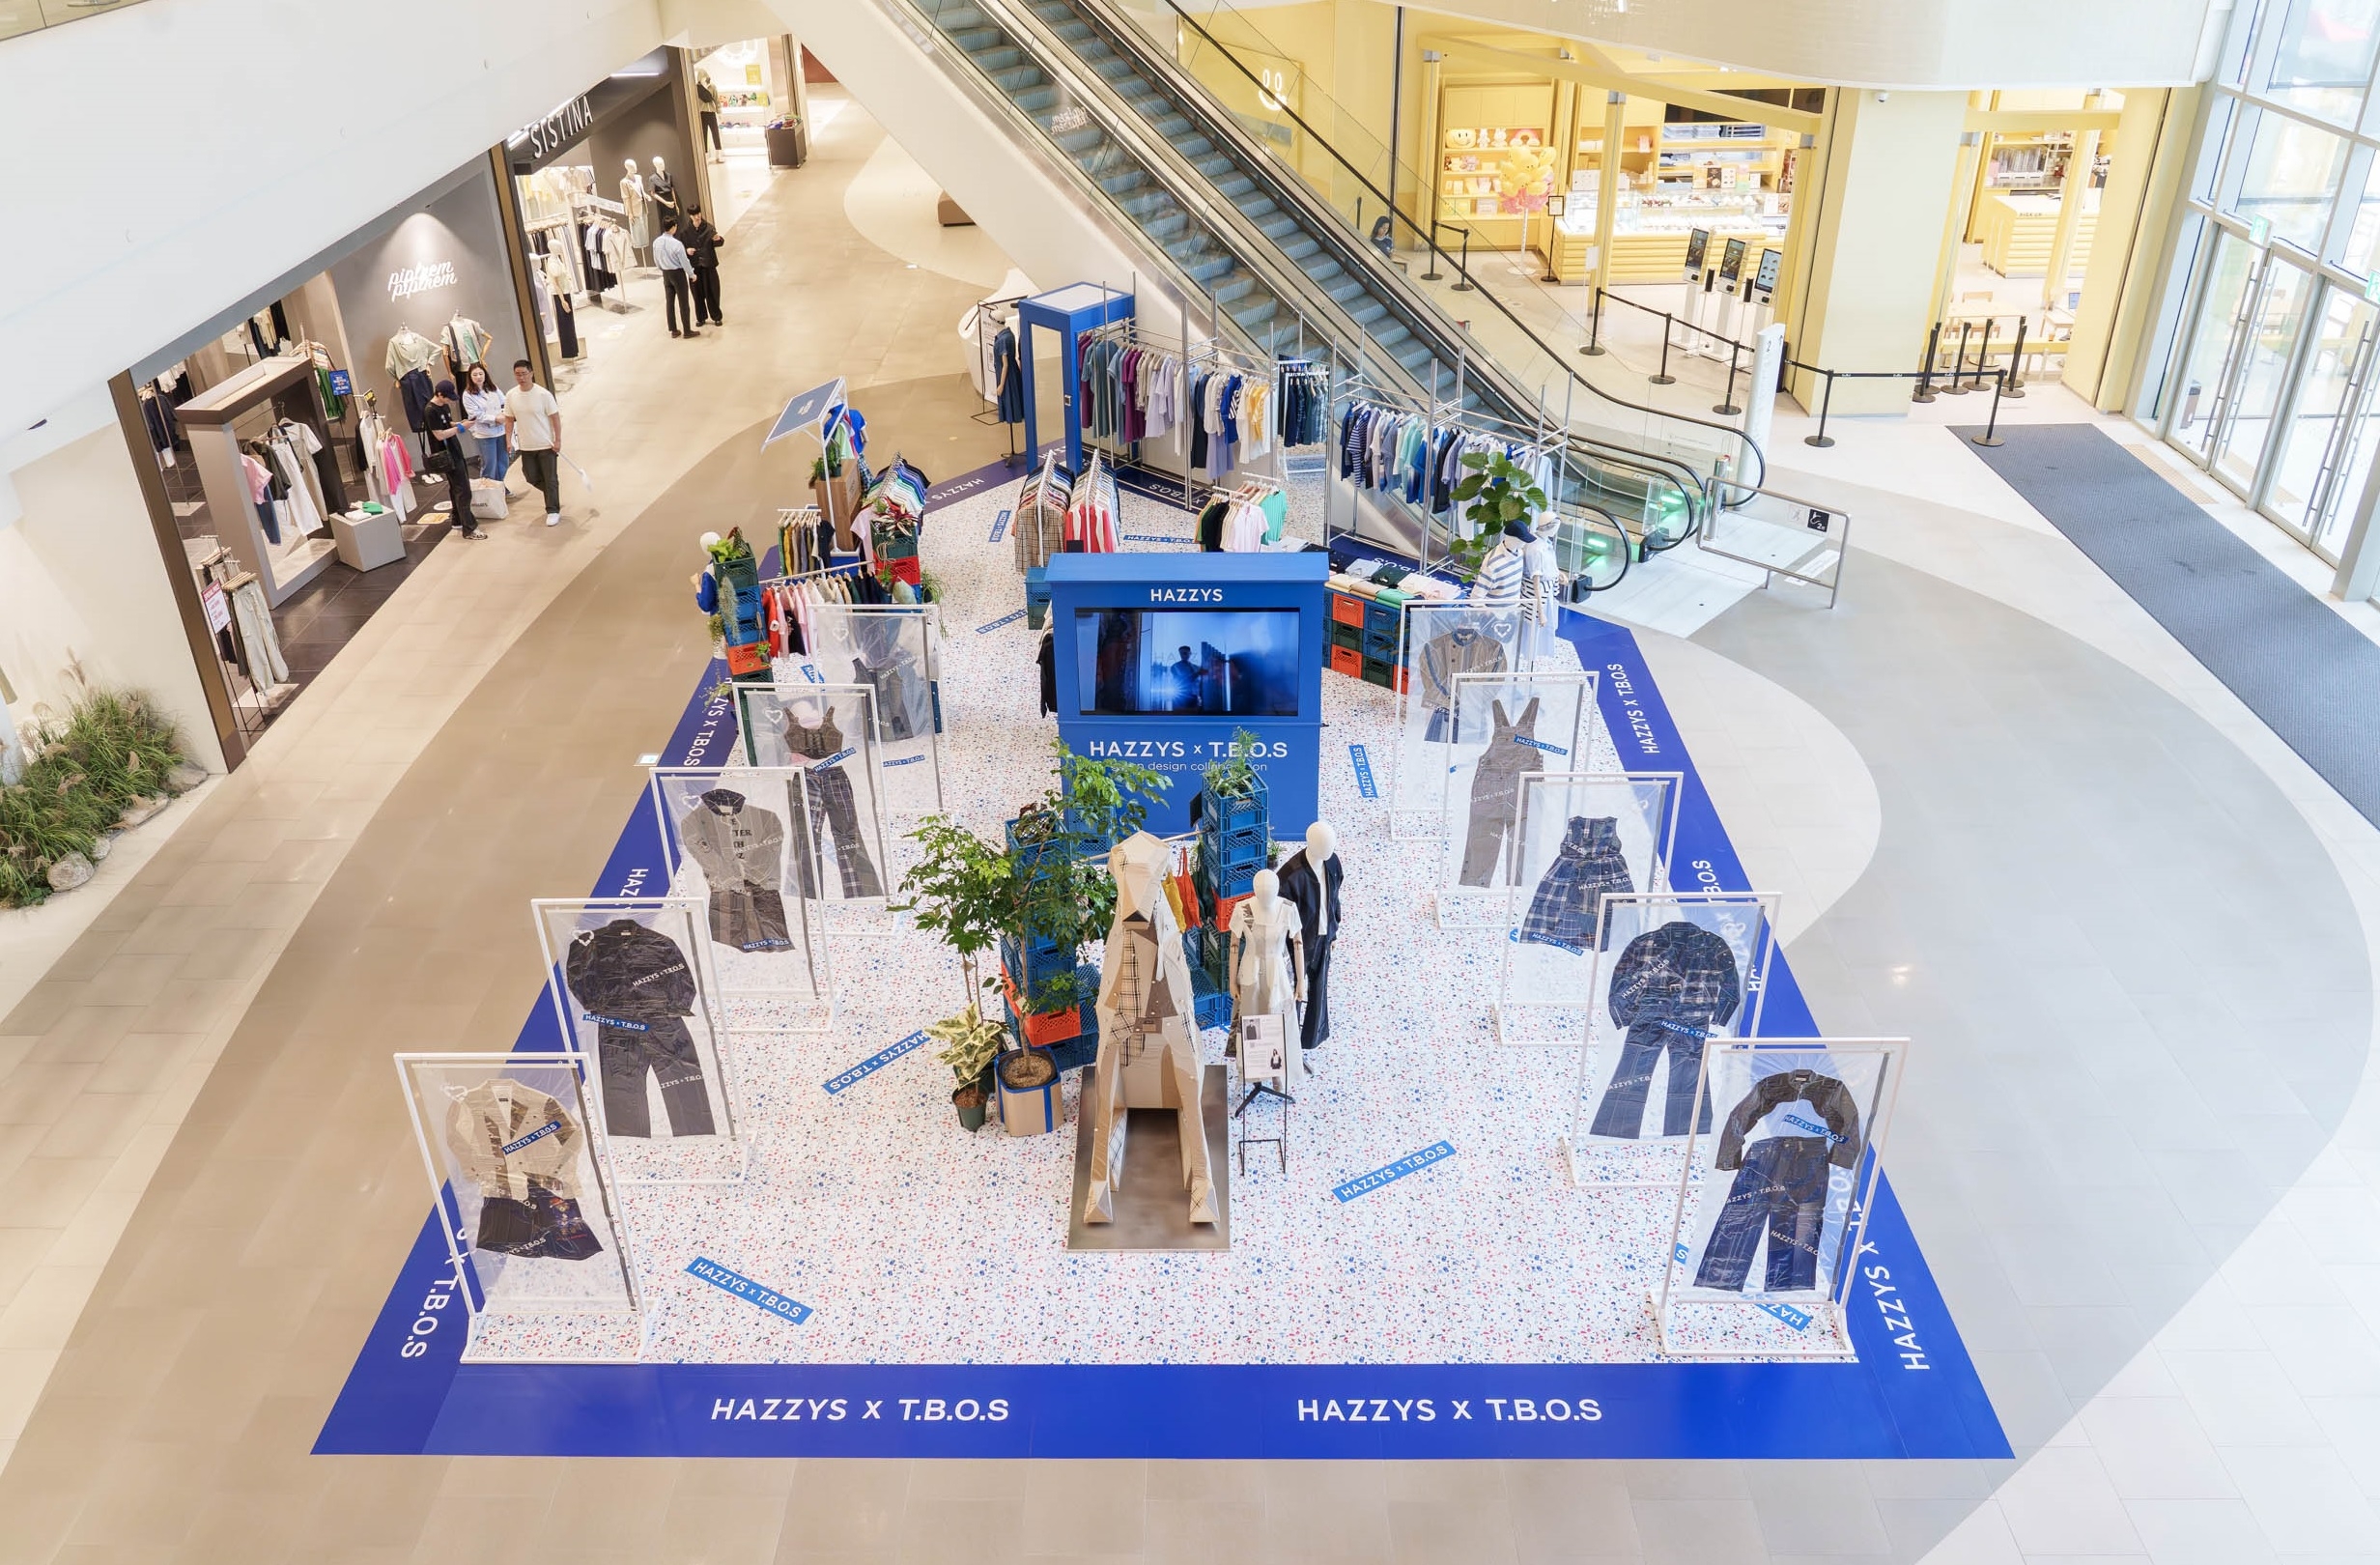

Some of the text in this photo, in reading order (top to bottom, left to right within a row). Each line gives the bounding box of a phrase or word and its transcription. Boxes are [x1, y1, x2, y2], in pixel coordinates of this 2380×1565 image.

[531, 96, 593, 158] SISTINA
[931, 478, 984, 500] HAZZYS
[1150, 588, 1224, 602] HAZZYS
[1606, 664, 1634, 697] T.B.O.S
[1516, 737, 1540, 748] HAZZYS
[1627, 710, 1660, 754] HAZZYS
[683, 729, 715, 767] T.B.O.S
[1090, 741, 1185, 757] HAZZYS
[1208, 741, 1288, 758] T.B.O.S
[1148, 762, 1187, 772] design
[1359, 771, 1375, 797] HAZZYS
[619, 868, 649, 896] HAZ
[743, 940, 768, 950] HAZZYS
[1532, 932, 1555, 945] HAZZYS
[632, 974, 660, 986] HAZZYS
[663, 963, 686, 975] T.B.O.S
[1621, 978, 1646, 999] HAZZYS
[585, 1014, 614, 1025] HAZZYS
[621, 1021, 645, 1031] T.B.O.S
[1661, 1020, 1688, 1033] HAZZYS
[879, 1032, 928, 1063] HAZZYS
[829, 1065, 873, 1090] T.B.O.S
[1785, 1115, 1814, 1130] HAZZYS
[503, 1137, 531, 1153] HAZZYS
[534, 1124, 557, 1137] T.B.O.S
[1341, 1168, 1396, 1198] HAZZYS
[1403, 1145, 1448, 1169] T.B.O.S
[1727, 1192, 1752, 1204] AZZYS
[1771, 1230, 1799, 1246] HAZZYS
[693, 1261, 749, 1293] HAZZYS
[756, 1291, 802, 1318] T.B.O.S
[401, 1274, 459, 1358] T.B.O.S
[1863, 1264, 1931, 1370] HAZZYS
[711, 1398, 848, 1421] HAZZYS
[898, 1398, 1009, 1421] T.B.O.S
[1297, 1398, 1436, 1421] HAZZYS
[1485, 1398, 1602, 1421] T.B.O.S
